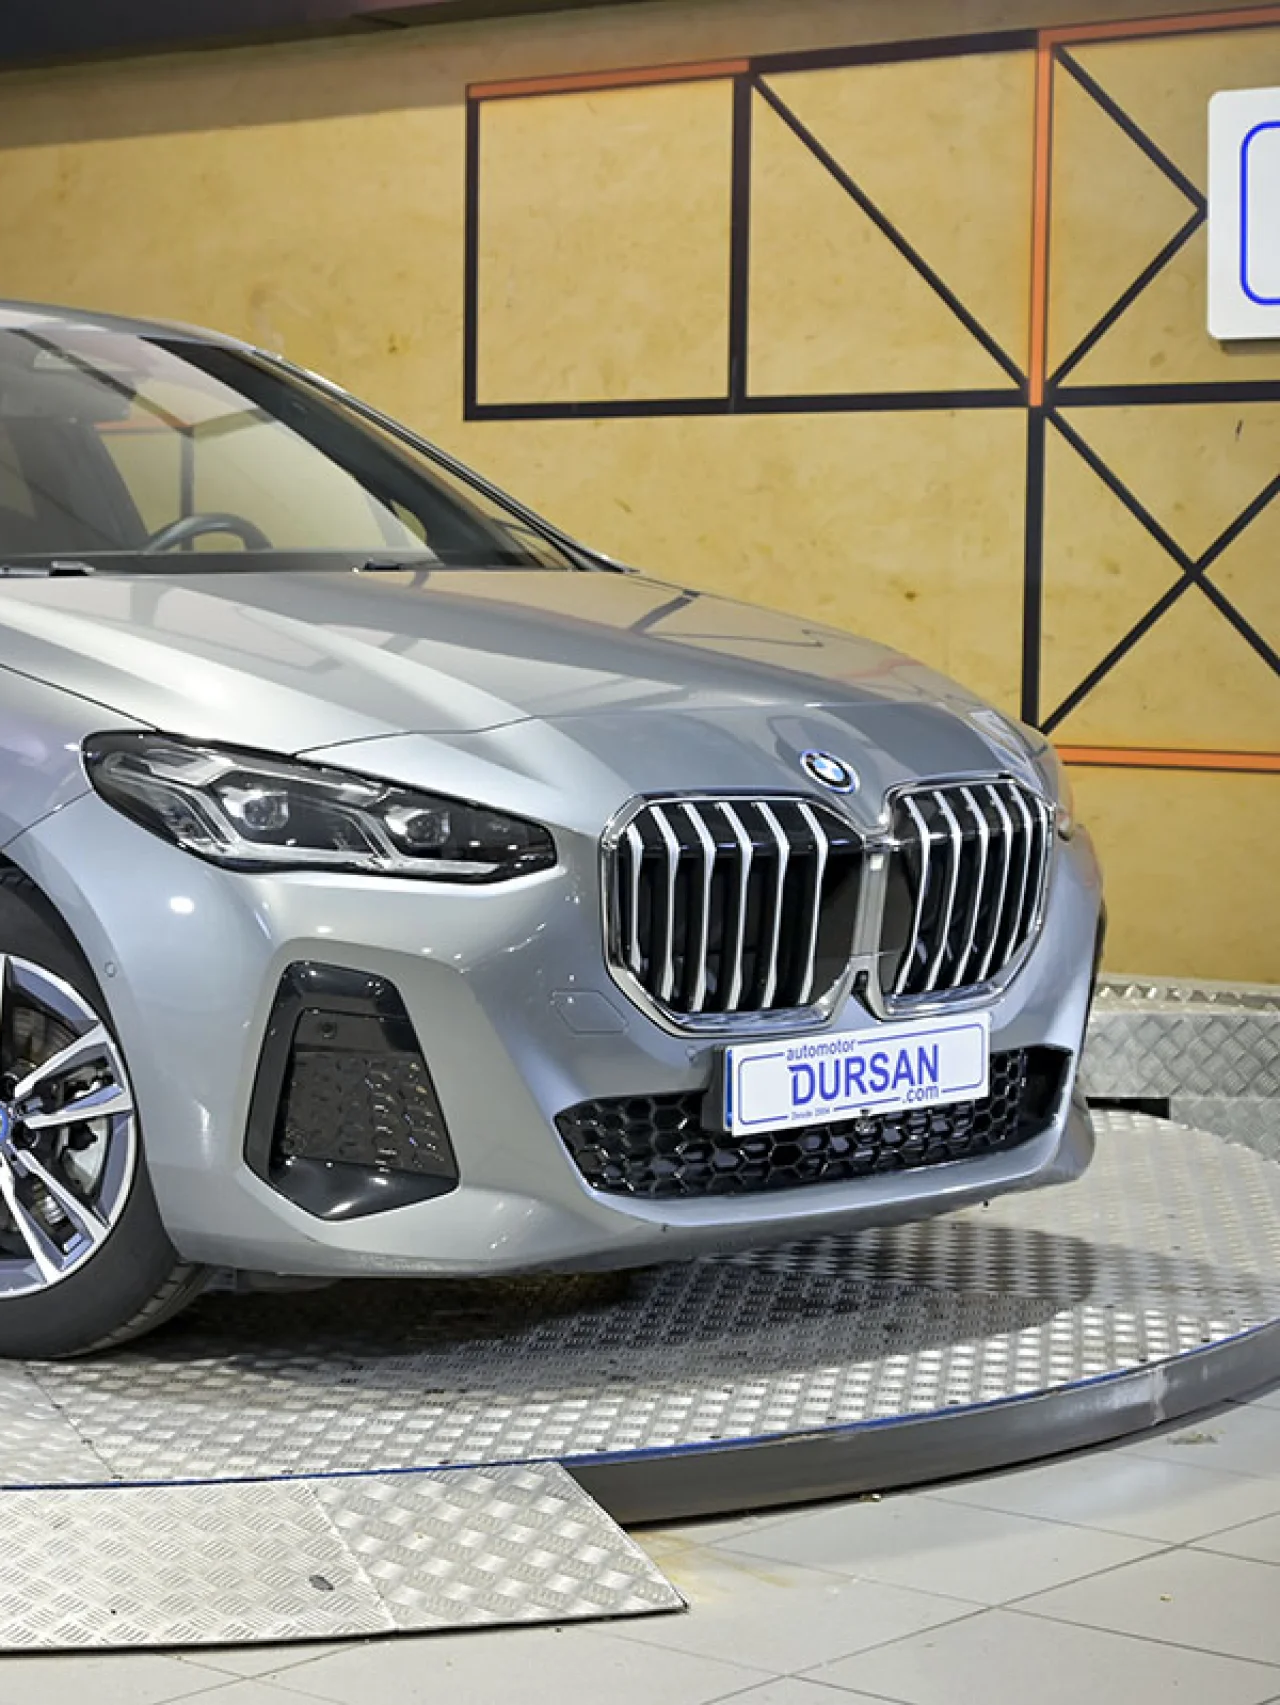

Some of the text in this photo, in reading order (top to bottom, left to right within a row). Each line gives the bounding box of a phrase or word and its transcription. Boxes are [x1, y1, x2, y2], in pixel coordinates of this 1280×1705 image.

[786, 1039, 856, 1061] automotor
[787, 1044, 939, 1106] DURSAN
[902, 1086, 939, 1103] .com
